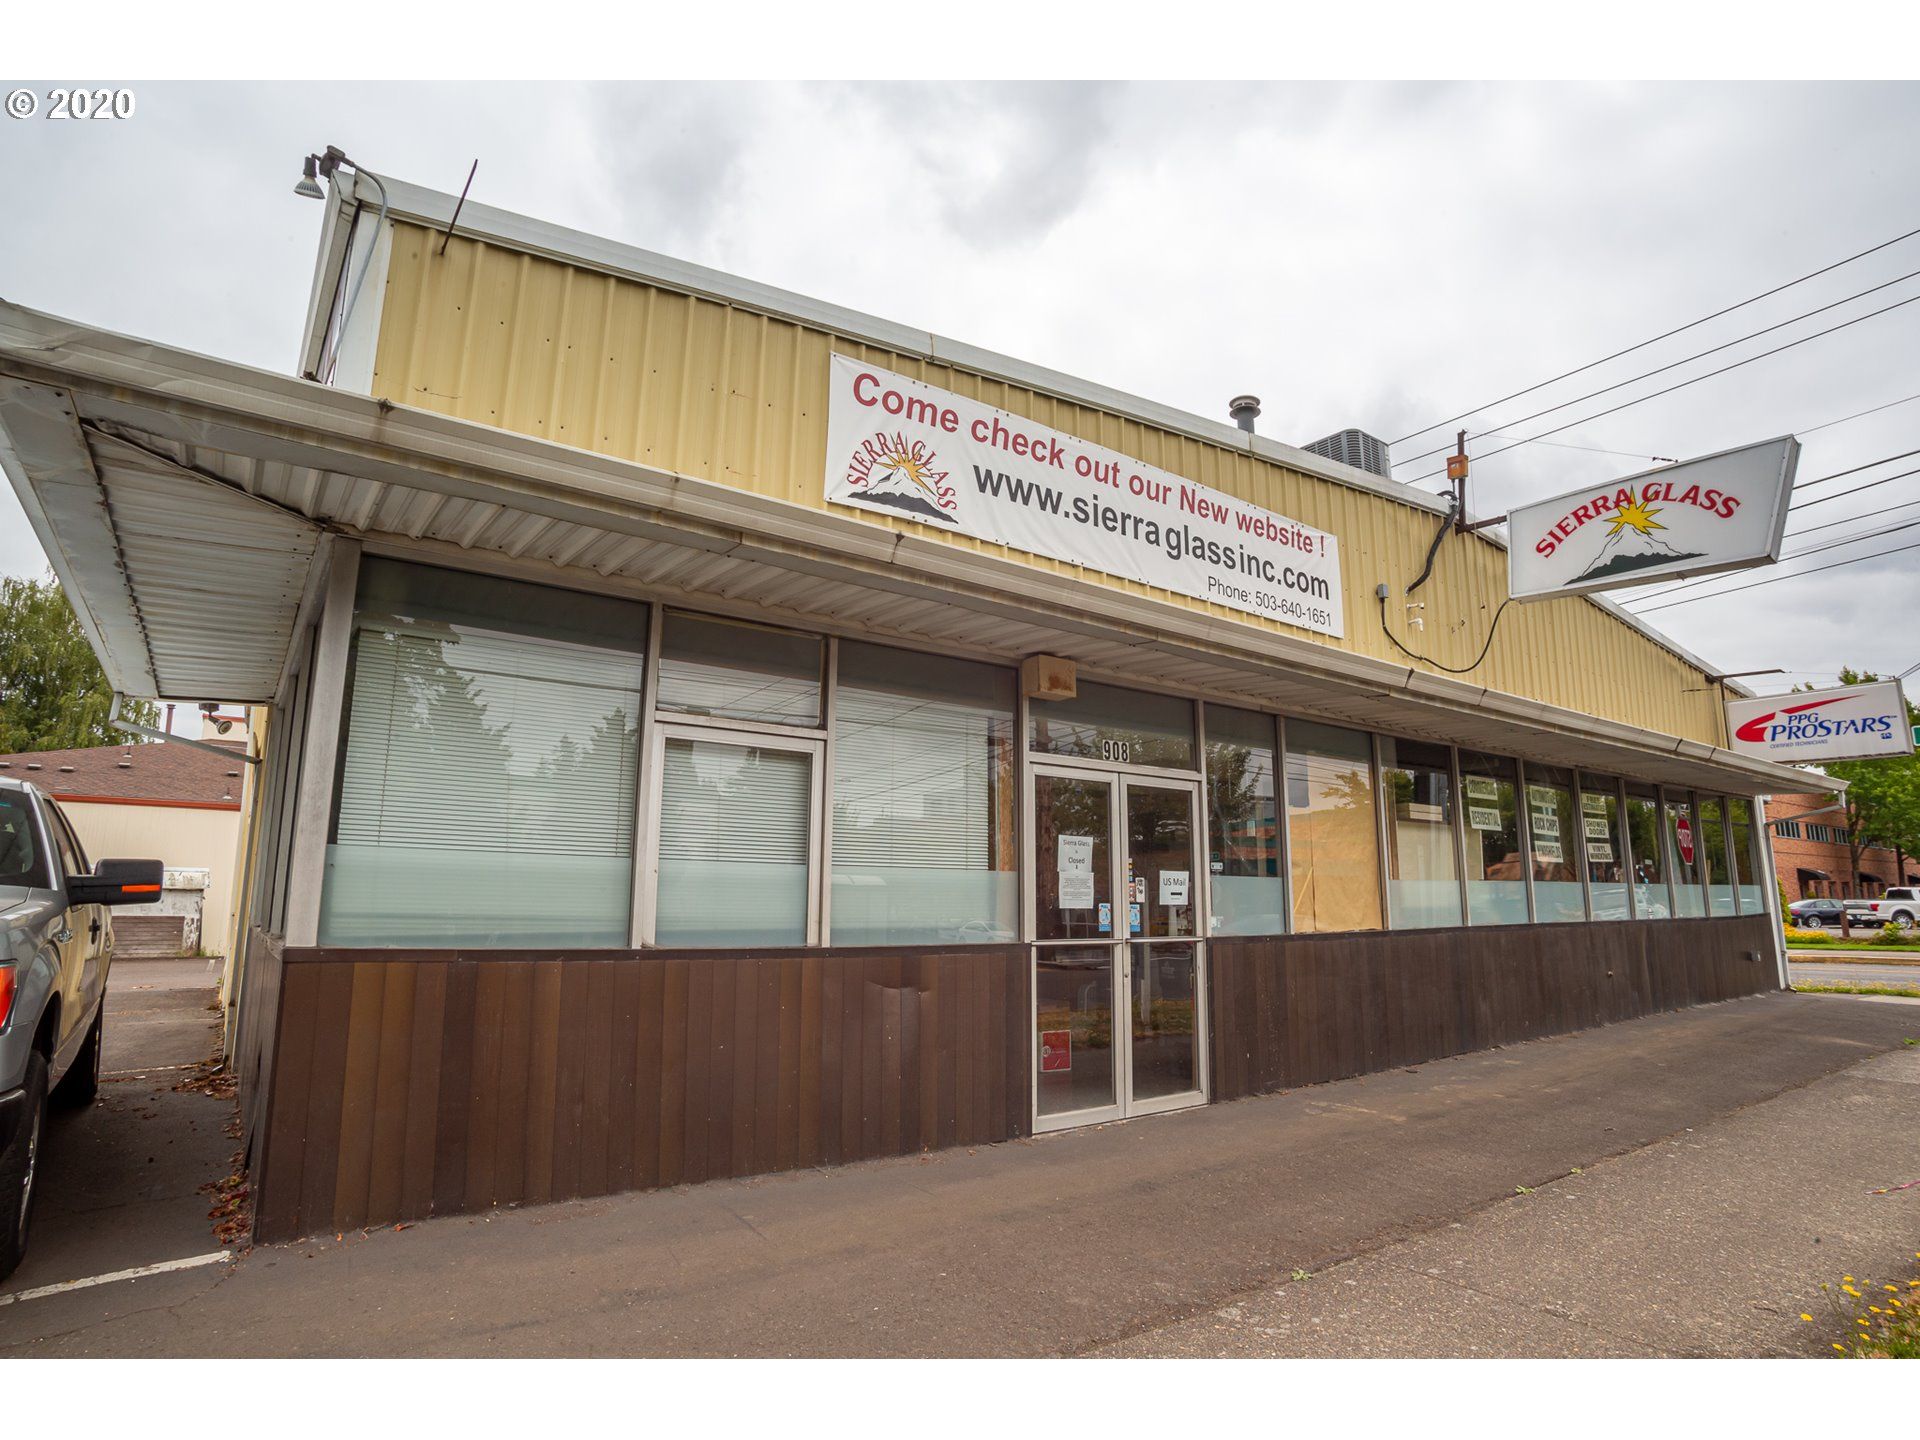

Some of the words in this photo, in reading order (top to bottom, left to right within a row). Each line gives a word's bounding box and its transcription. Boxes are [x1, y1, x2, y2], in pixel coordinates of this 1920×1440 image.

[846, 431, 906, 488] SIERRA
[911, 440, 958, 510] GLASS
[853, 372, 959, 433] Come
[971, 418, 1065, 469] check
[1074, 454, 1121, 489] out
[1129, 474, 1172, 506] our
[1180, 485, 1230, 525] New
[1235, 511, 1313, 554] website
[1535, 487, 1635, 559] SIERRA
[1641, 482, 1742, 520] GLASS
[972, 464, 1330, 601] www.sierraglassinc.com
[1208, 576, 1252, 604] Phone:
[1255, 591, 1332, 627] 503-640-1651
[1787, 712, 1819, 726] PPG
[1769, 715, 1893, 742] PROSTARS
[1102, 740, 1129, 762] 908
[1533, 815, 1546, 831] ROCK
[1586, 820, 1608, 830] SHOWER
[1588, 827, 1606, 836] DOORS
[1063, 839, 1077, 847] Sierra
[1077, 839, 1090, 848] Glass
[1591, 845, 1608, 853] VINYL
[1068, 856, 1086, 865] Closed
[1590, 852, 1612, 860] WINDOWS
[1162, 877, 1172, 887] US
[1172, 877, 1187, 887] Mail
